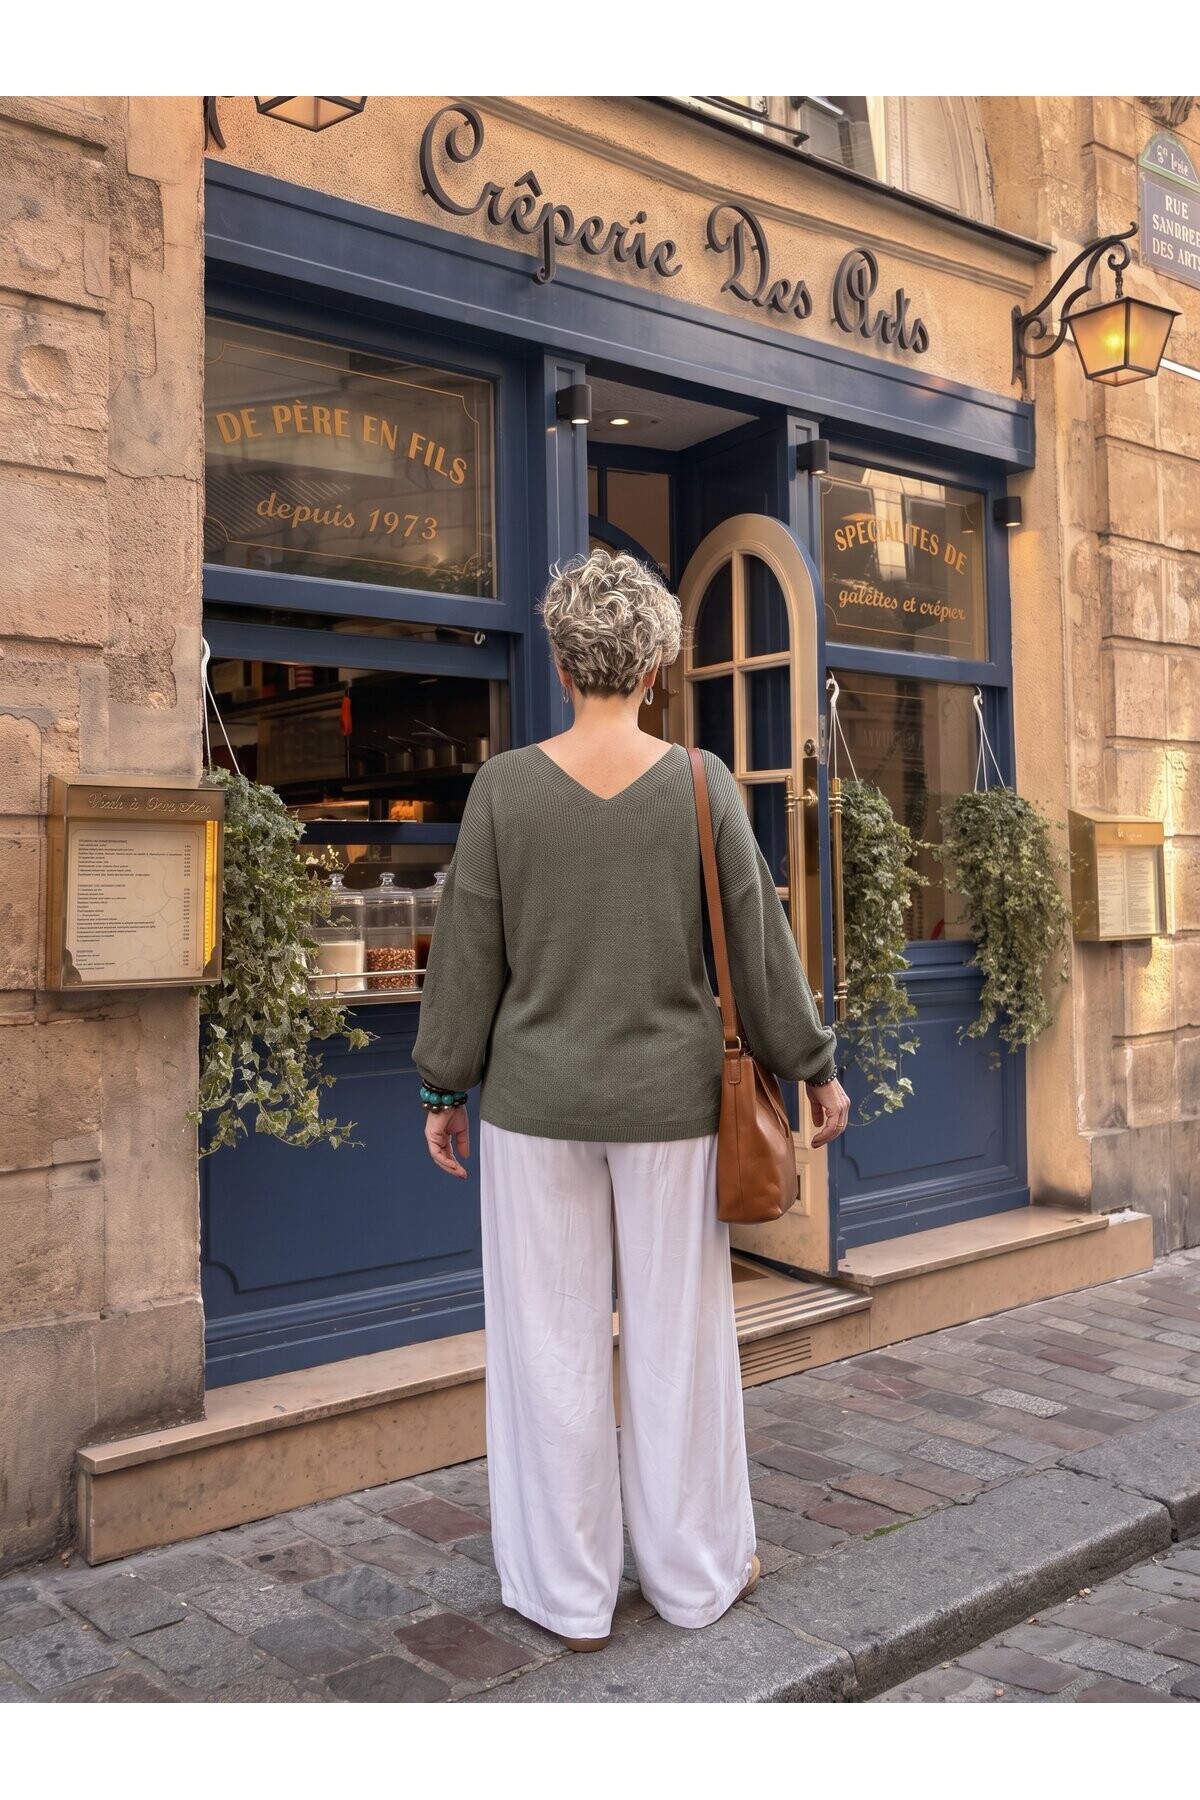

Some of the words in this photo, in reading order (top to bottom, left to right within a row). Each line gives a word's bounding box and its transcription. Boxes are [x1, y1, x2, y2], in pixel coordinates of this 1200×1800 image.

[1165, 194, 1189, 220] RUE
[419, 103, 683, 285] Crêperie
[705, 202, 813, 319] Des
[832, 247, 929, 353] Arts
[1152, 236, 1174, 261] DES
[216, 408, 263, 443] DE
[272, 400, 351, 438] PÈRE
[363, 415, 398, 450] EN
[408, 432, 467, 485] FILS
[257, 493, 355, 529] depuis
[369, 508, 438, 540] 1973
[944, 543, 968, 575] DE
[903, 597, 917, 612] et
